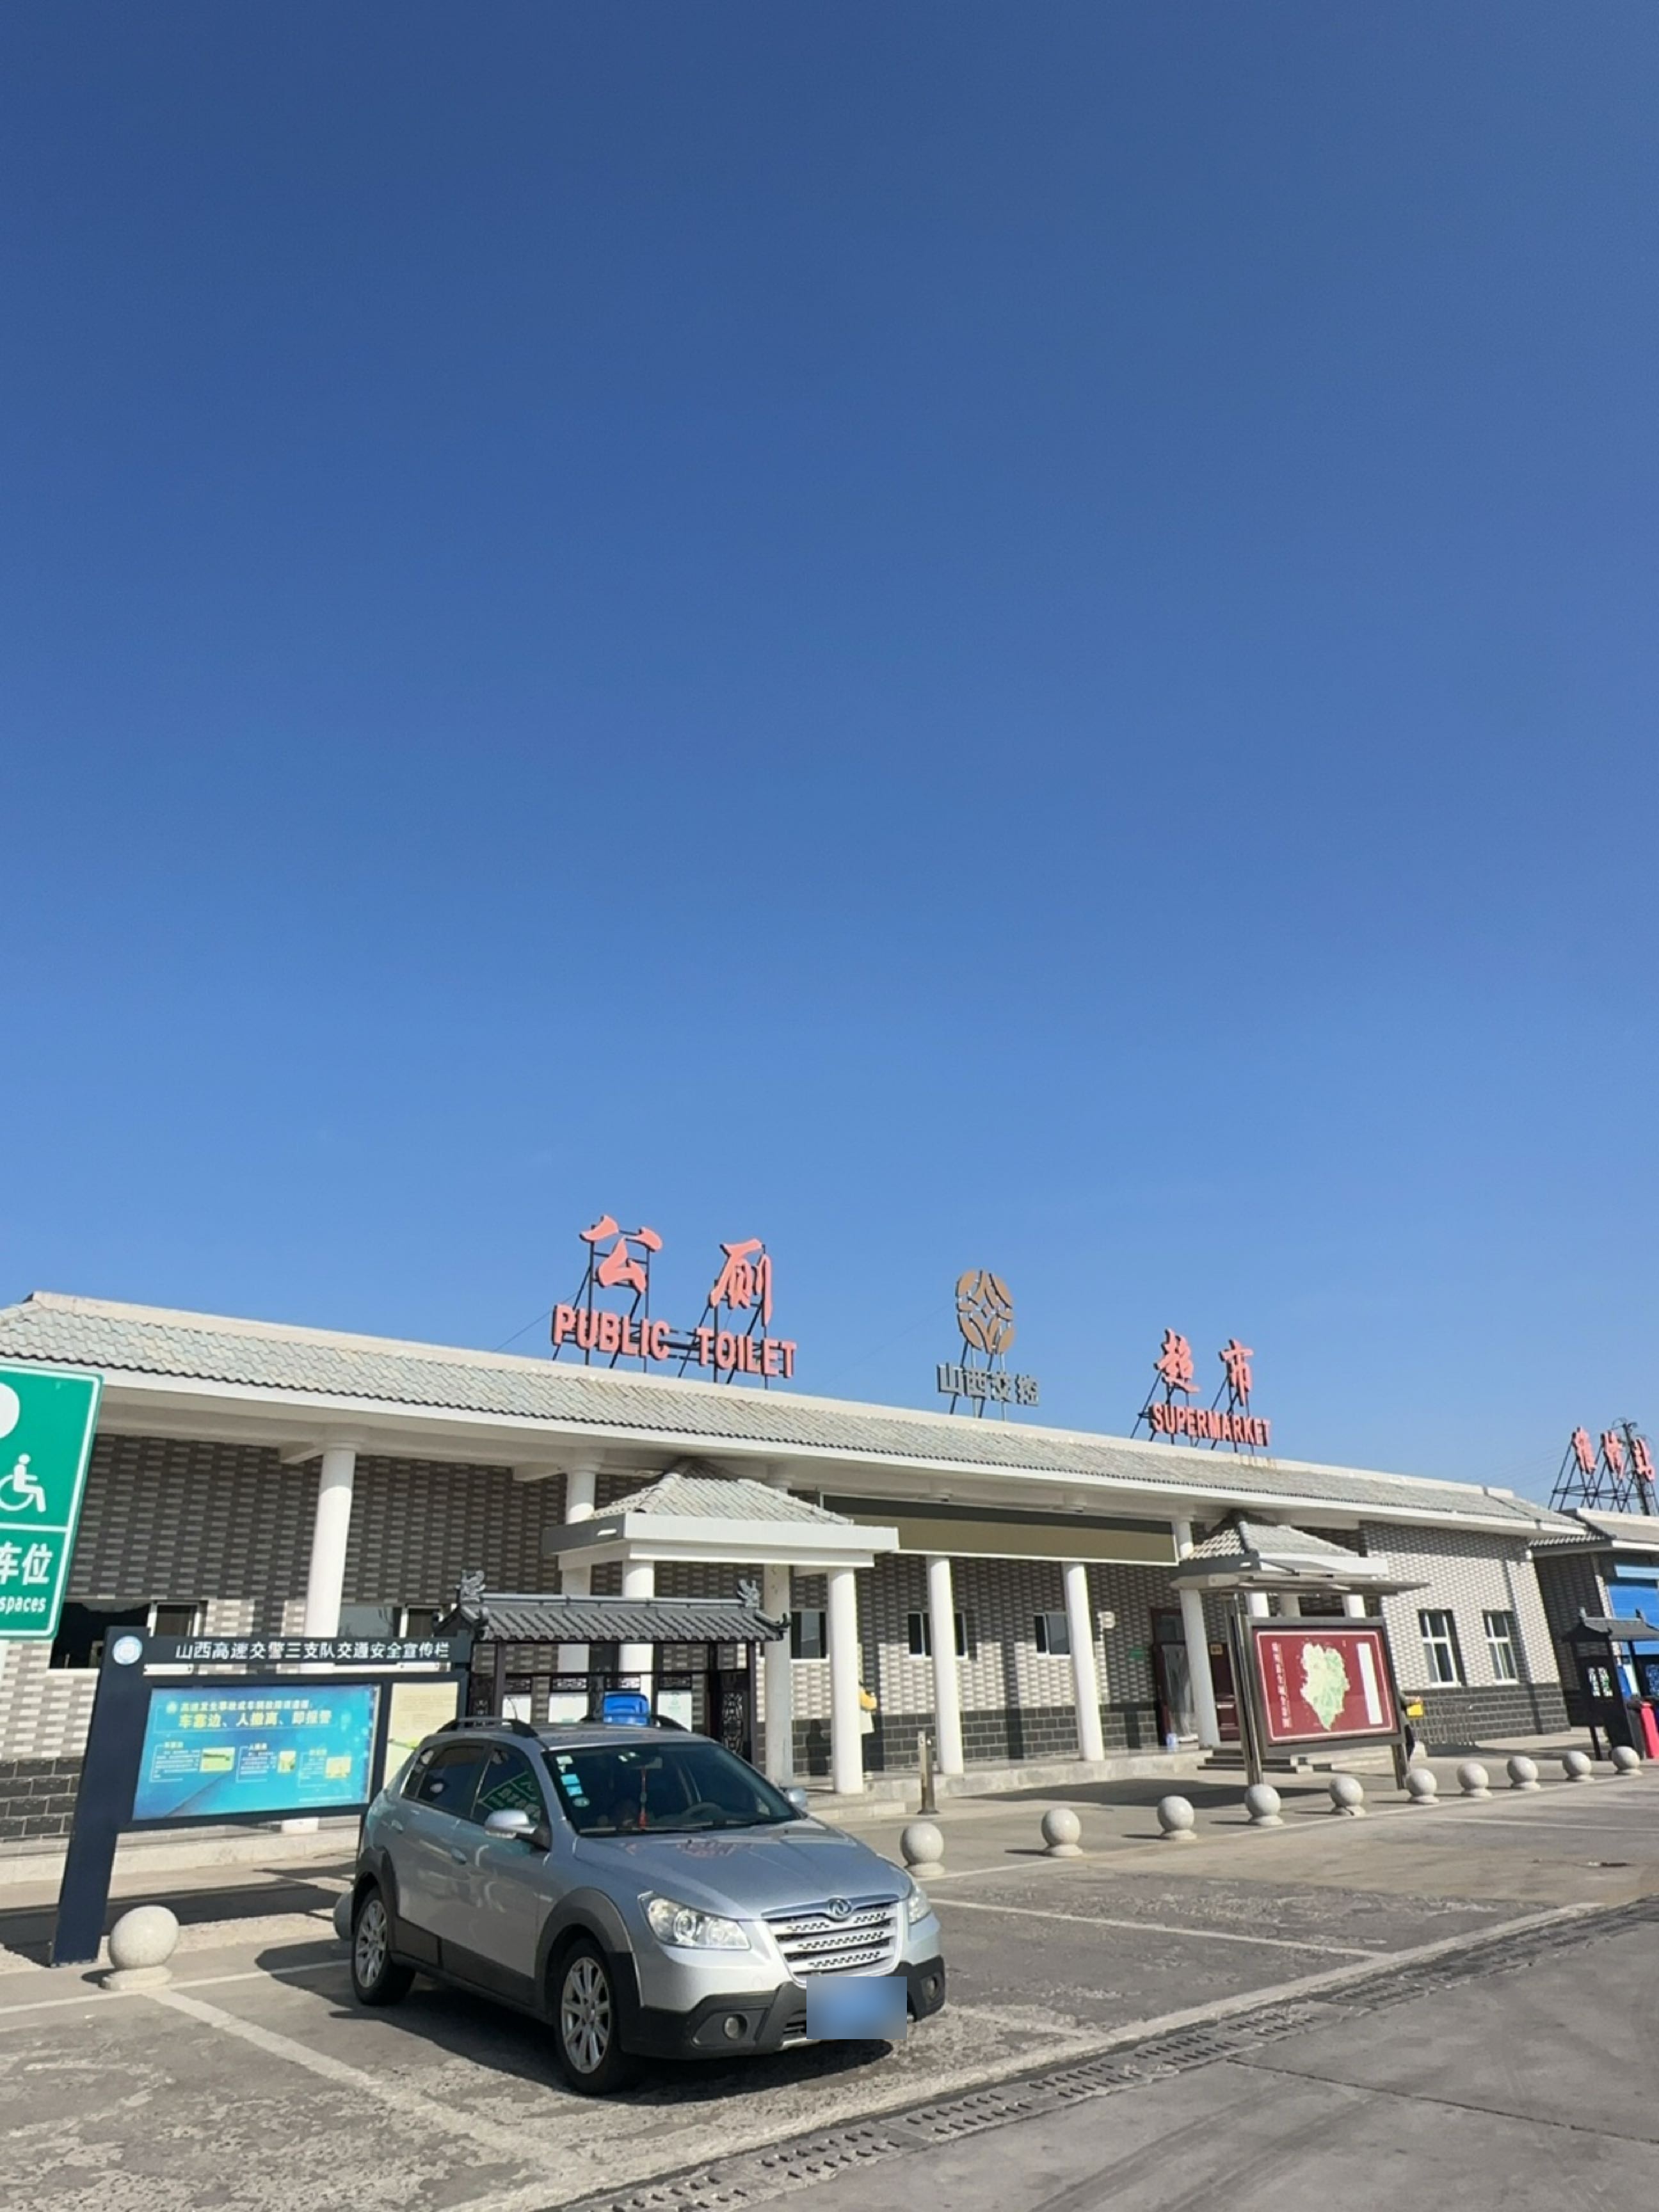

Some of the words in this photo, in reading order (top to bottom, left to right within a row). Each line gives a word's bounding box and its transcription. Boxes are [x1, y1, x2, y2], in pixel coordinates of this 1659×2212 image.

[579, 1215, 773, 1327] 公厕
[553, 1303, 670, 1361] PUBLIC
[695, 1327, 797, 1378] TOILET
[1153, 1327, 1254, 1407] 超市
[936, 1363, 1039, 1406] 山西交控
[1150, 1402, 1270, 1447] SUPERMARKET
[175, 1640, 450, 1660] 山西高速交警三支队交通安全宣传栏
